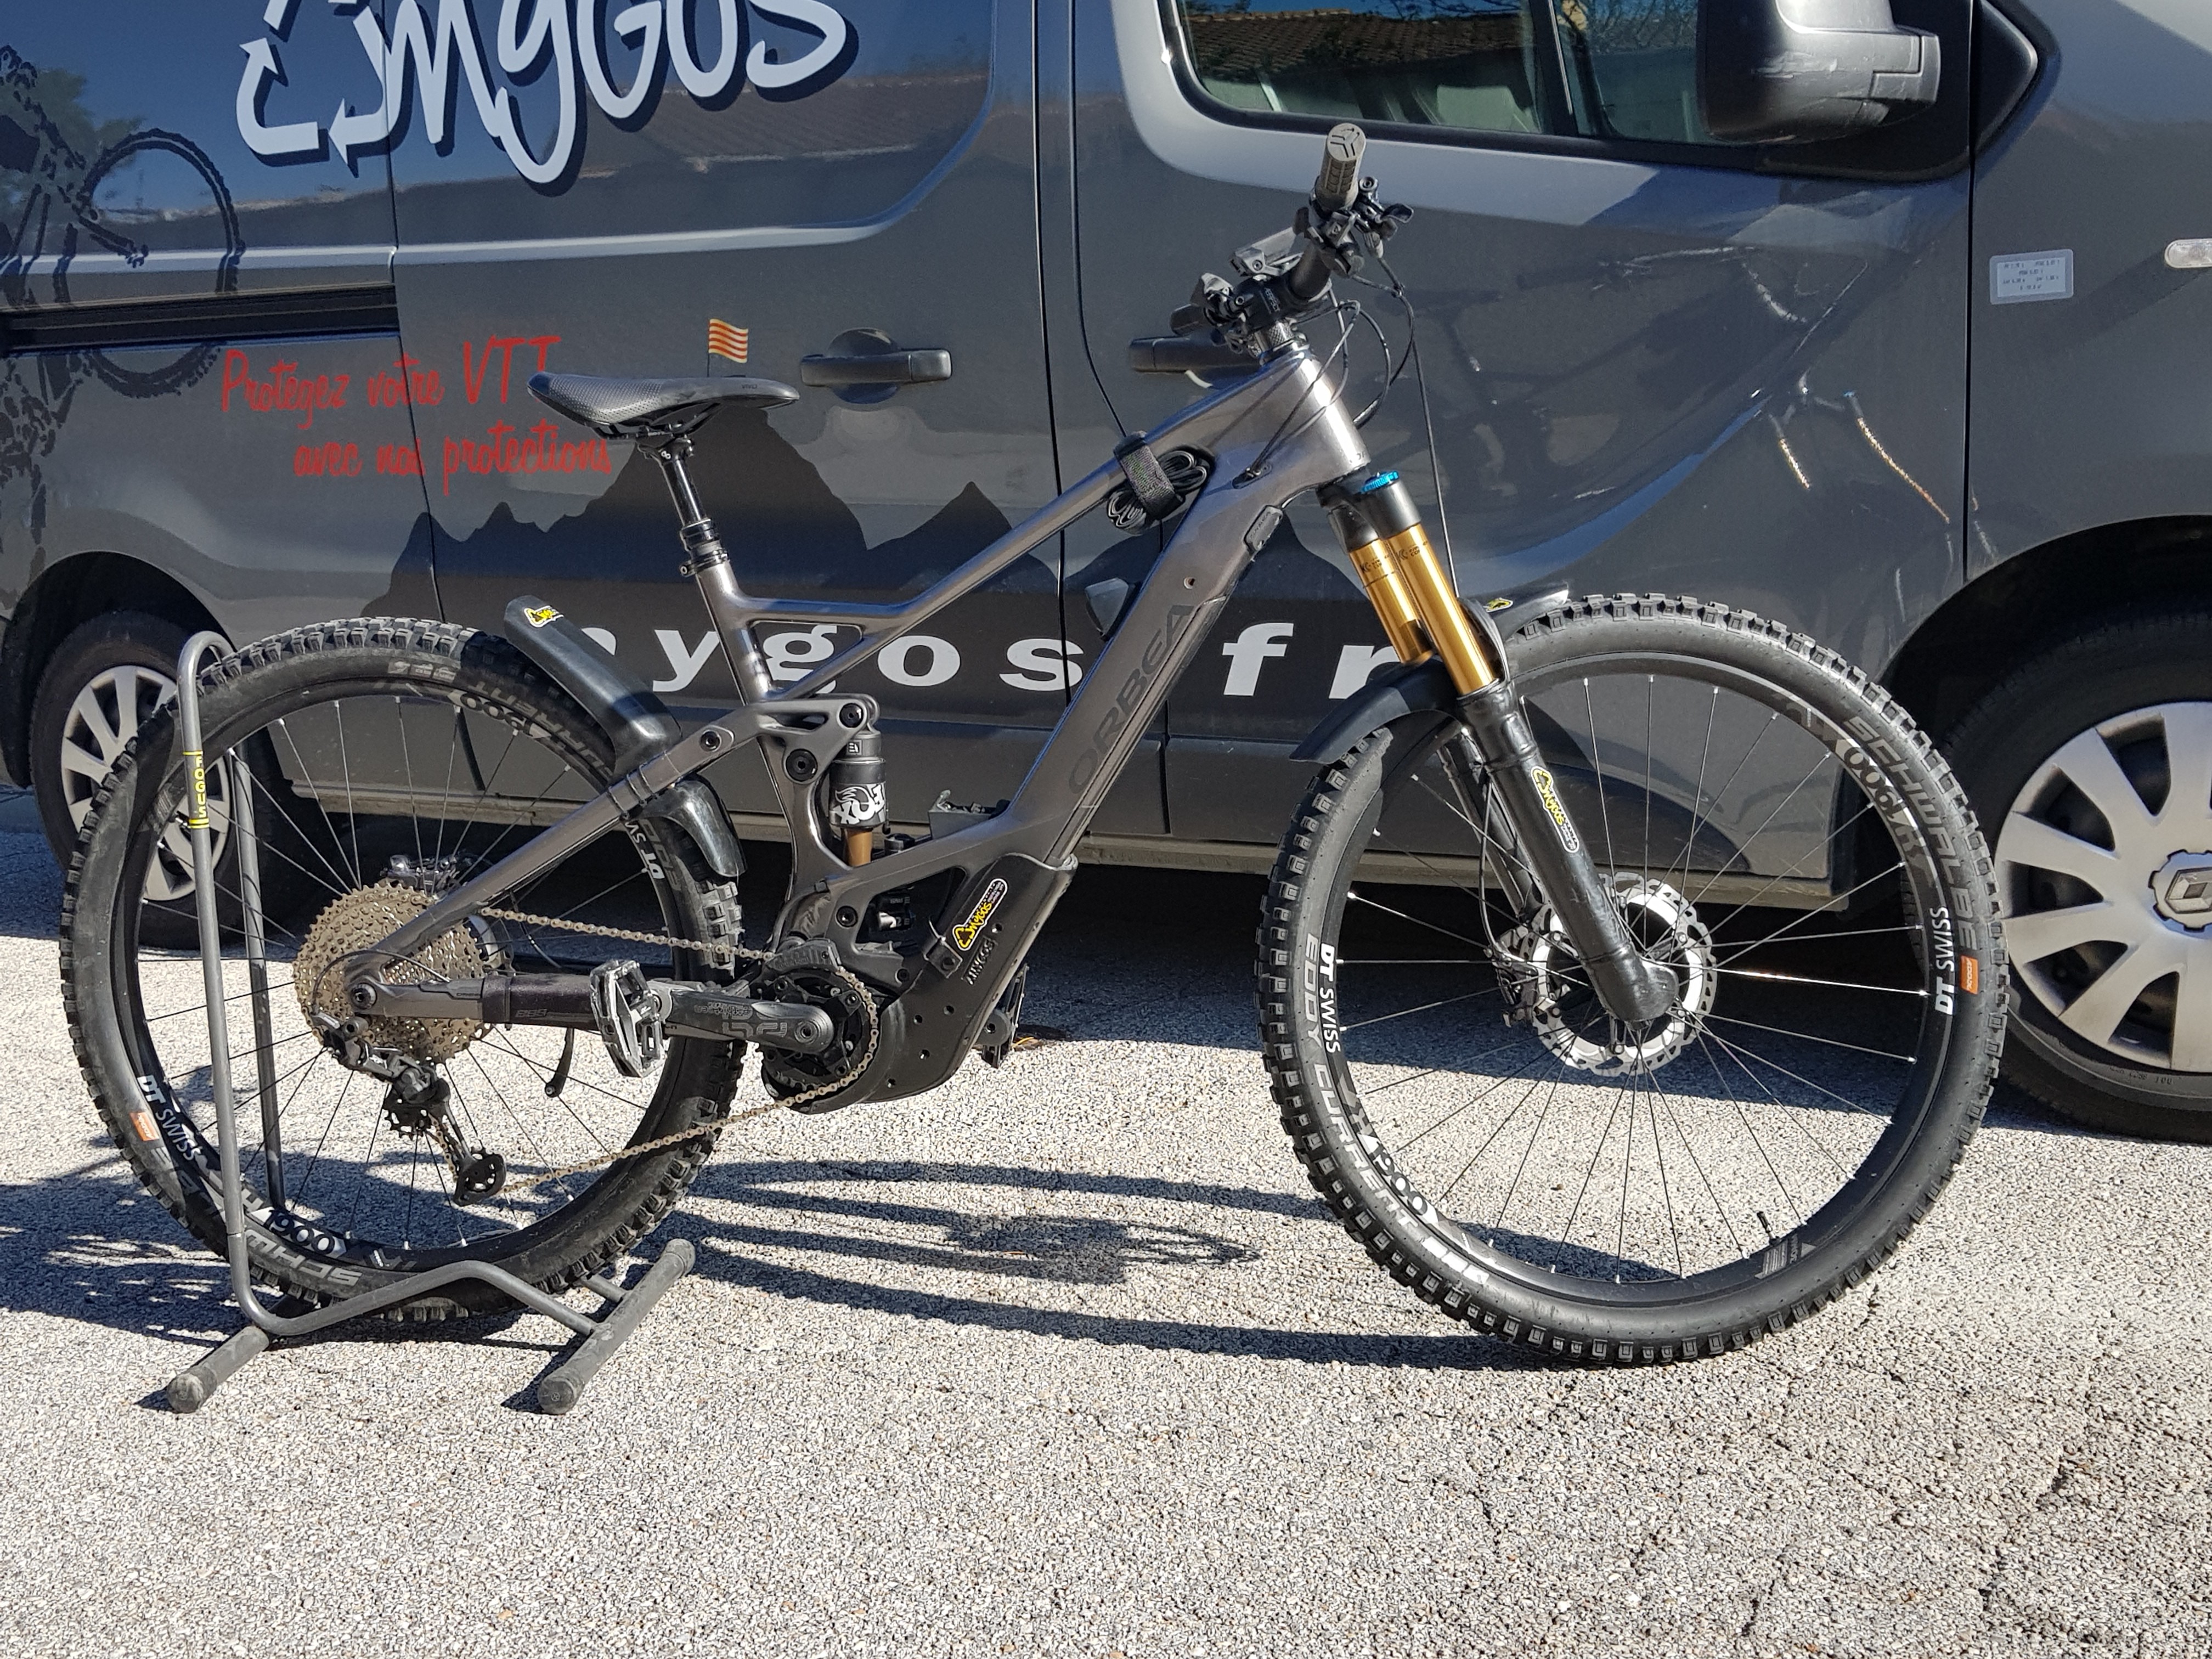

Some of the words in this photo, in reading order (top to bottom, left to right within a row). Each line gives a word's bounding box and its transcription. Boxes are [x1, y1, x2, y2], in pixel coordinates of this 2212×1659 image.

[367, 352, 445, 407] votre
[462, 334, 561, 404] VTT
[293, 441, 363, 476] avec
[376, 437, 425, 475] nos
[443, 417, 611, 496] protections
[1068, 605, 1194, 795] ORBEA
[832, 783, 886, 825] FOX
[1844, 747, 1903, 822] 1900
[639, 819, 682, 891] EDD
[641, 849, 665, 879] DT
[1847, 716, 1977, 950] SCHWALBE
[1319, 943, 1335, 981] DT
[1929, 906, 1955, 972] SWISS
[1321, 987, 1341, 1053] SWISS
[1934, 976, 1954, 1015] DT
[1304, 933, 1322, 1049] EDDY
[1314, 1064, 1420, 1228] CURRENT
[137, 1075, 166, 1104] DT
[155, 1109, 201, 1161] SWISS
[150, 1146, 363, 1286] SCHWLBE
[1373, 1146, 1429, 1216] 1900
[263, 1209, 336, 1256] 1900
